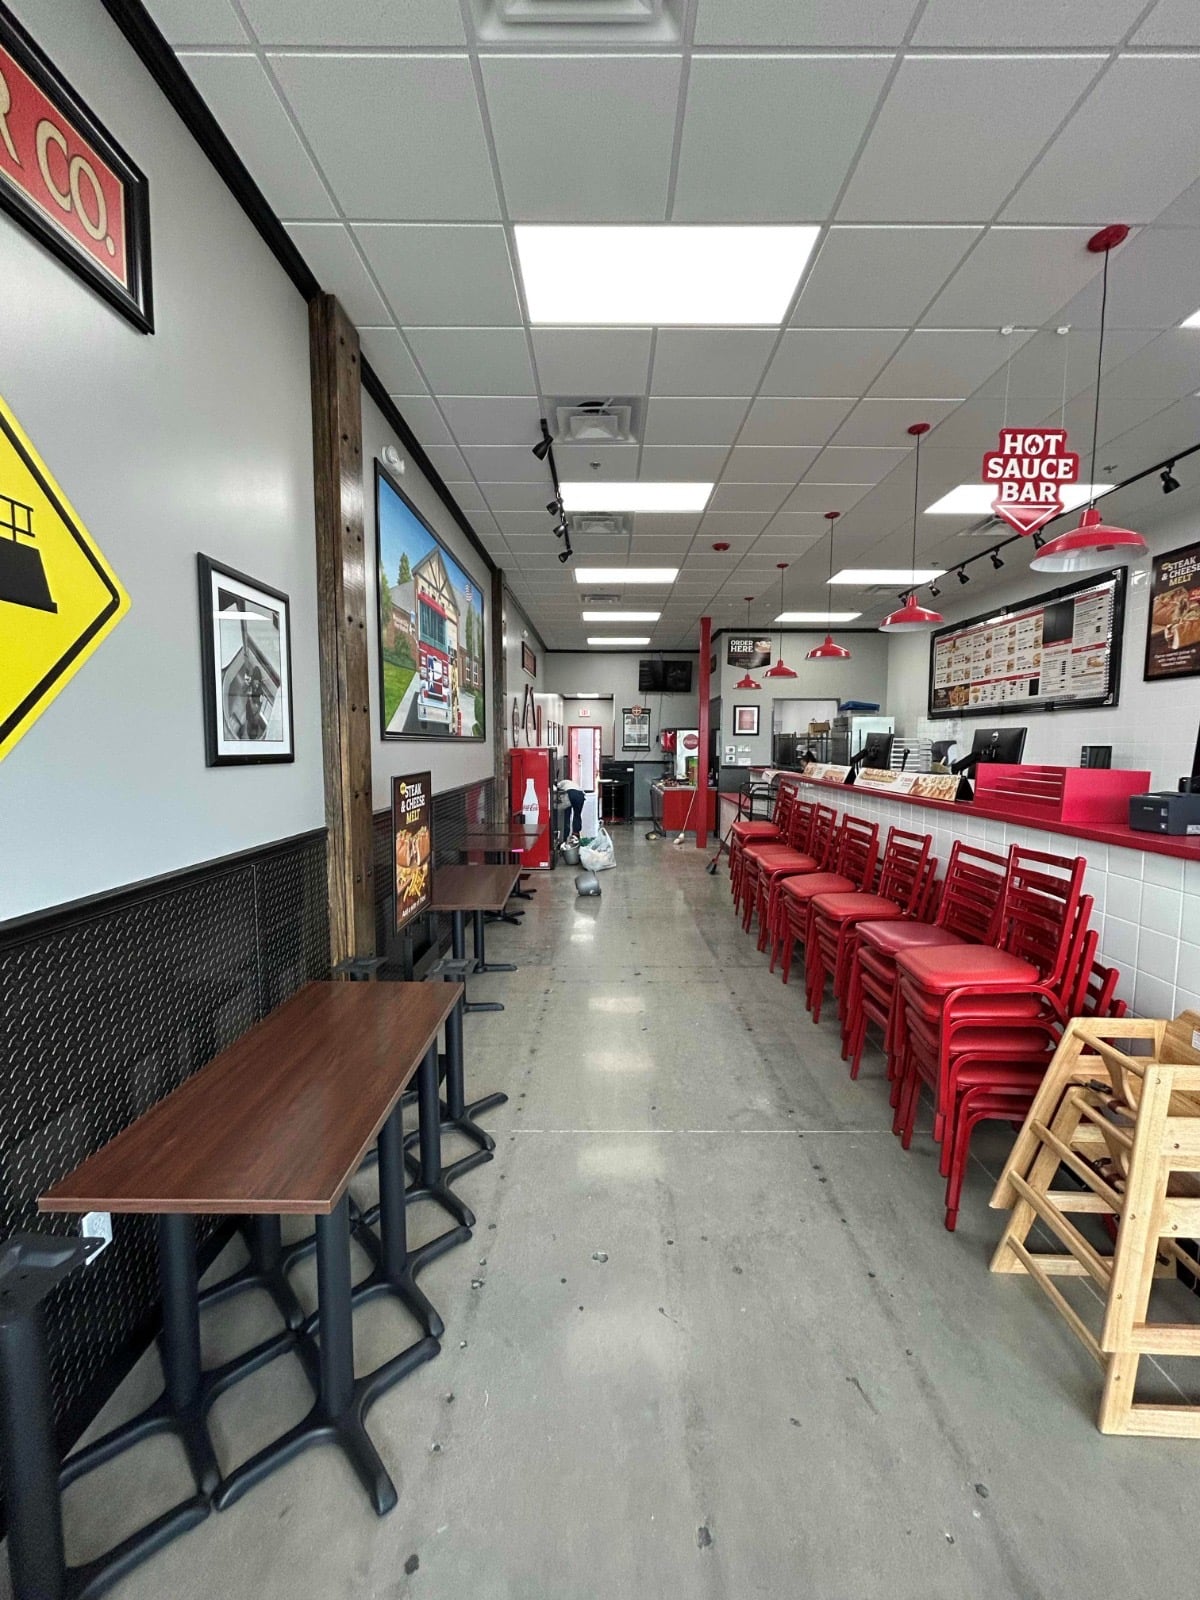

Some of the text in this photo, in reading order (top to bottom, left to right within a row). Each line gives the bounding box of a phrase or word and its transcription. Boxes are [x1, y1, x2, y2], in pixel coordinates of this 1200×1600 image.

[36, 118, 116, 258] CO.
[1003, 433, 1063, 456] HOT
[987, 457, 1074, 479] SAUCE
[1001, 481, 1057, 503] BAR
[1167, 556, 1197, 572] STEAK
[1161, 572, 1168, 581] &
[1168, 573, 1193, 587] MELT
[730, 645, 754, 653] HERE
[405, 783, 422, 799] STEAK
[401, 794, 426, 813] & CHEESE
[405, 808, 421, 825] MELT
